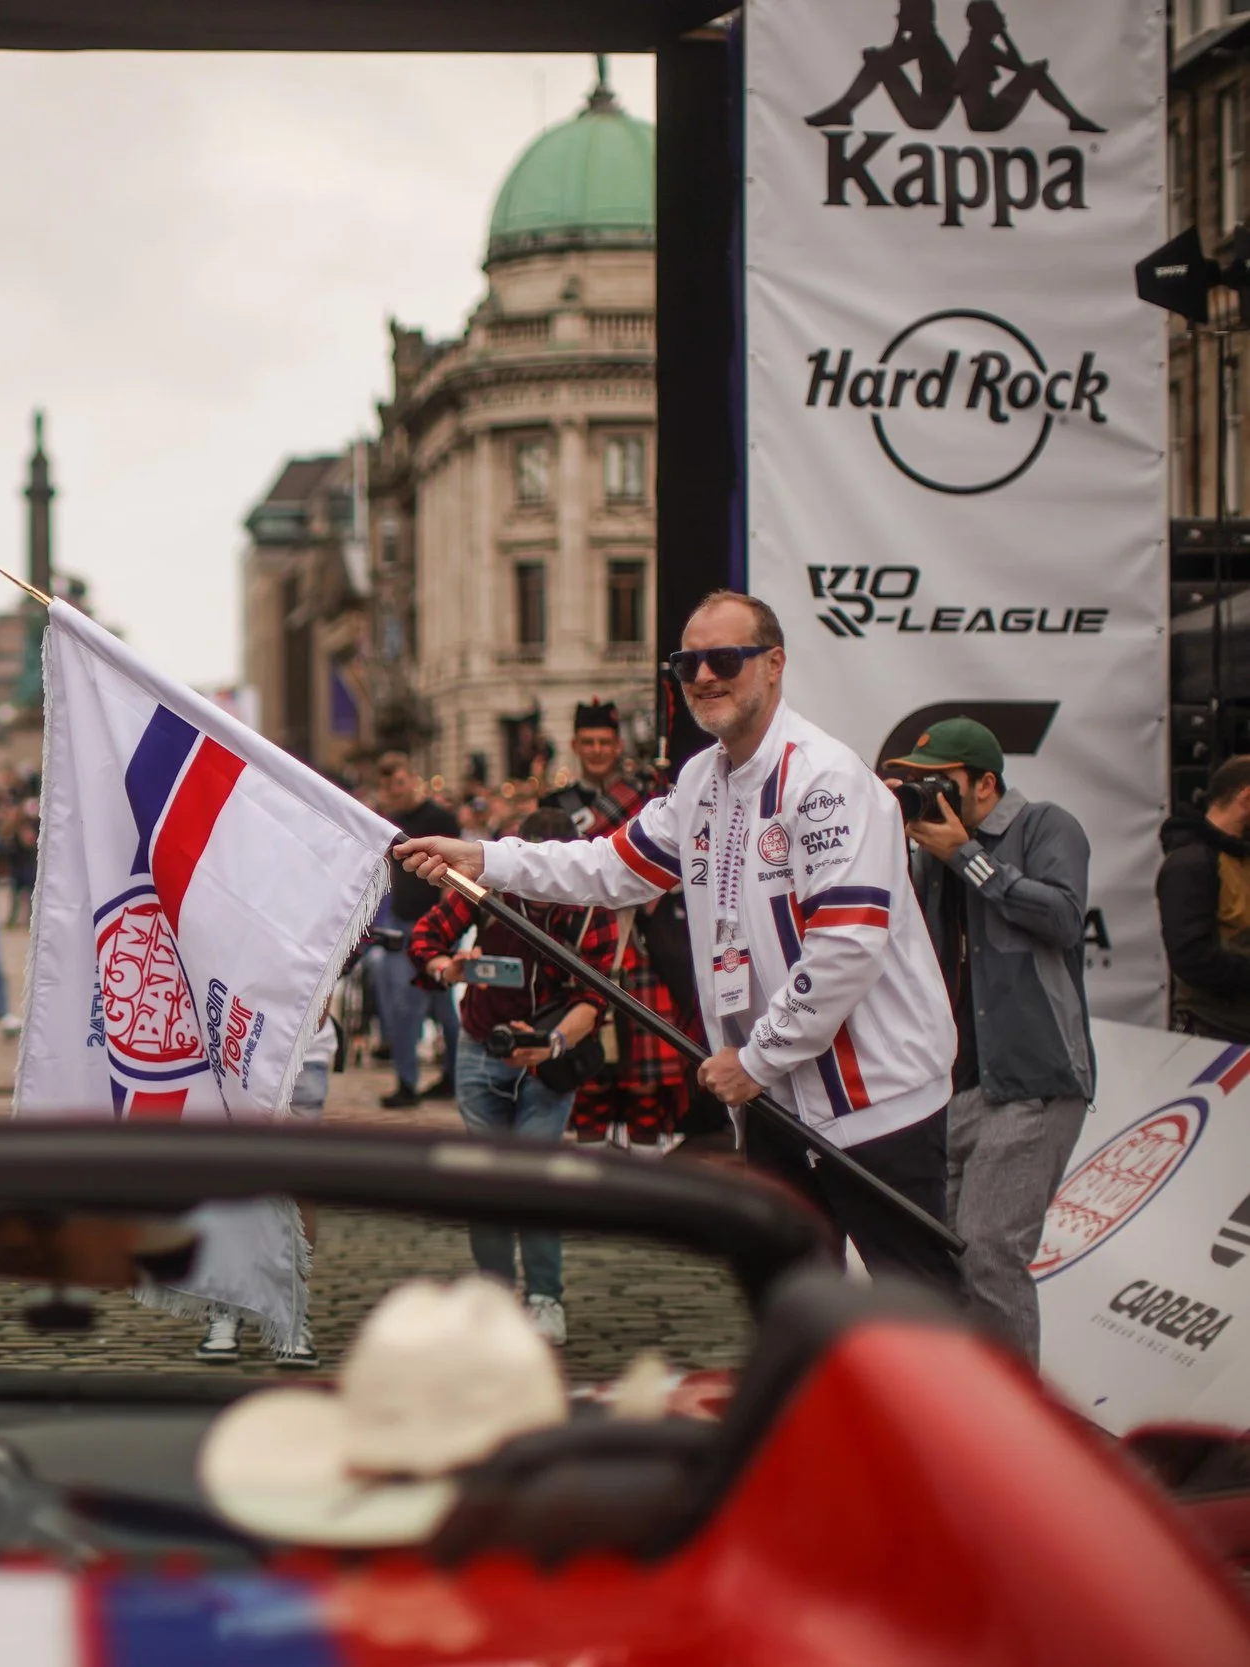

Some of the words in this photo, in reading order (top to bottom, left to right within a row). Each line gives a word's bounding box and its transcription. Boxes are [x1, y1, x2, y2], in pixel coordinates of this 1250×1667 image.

[822, 131, 1090, 227] Kappa
[805, 349, 960, 409] Hard
[966, 351, 1109, 424] Rock
[818, 793, 846, 810] Rock
[801, 825, 850, 846] QNTM
[806, 838, 843, 855] DNA
[791, 998, 818, 1015] CITIZEN
[243, 1037, 258, 1066] JUNE
[251, 1010, 265, 1040] 2025
[1109, 1279, 1234, 1352] CARRERA
